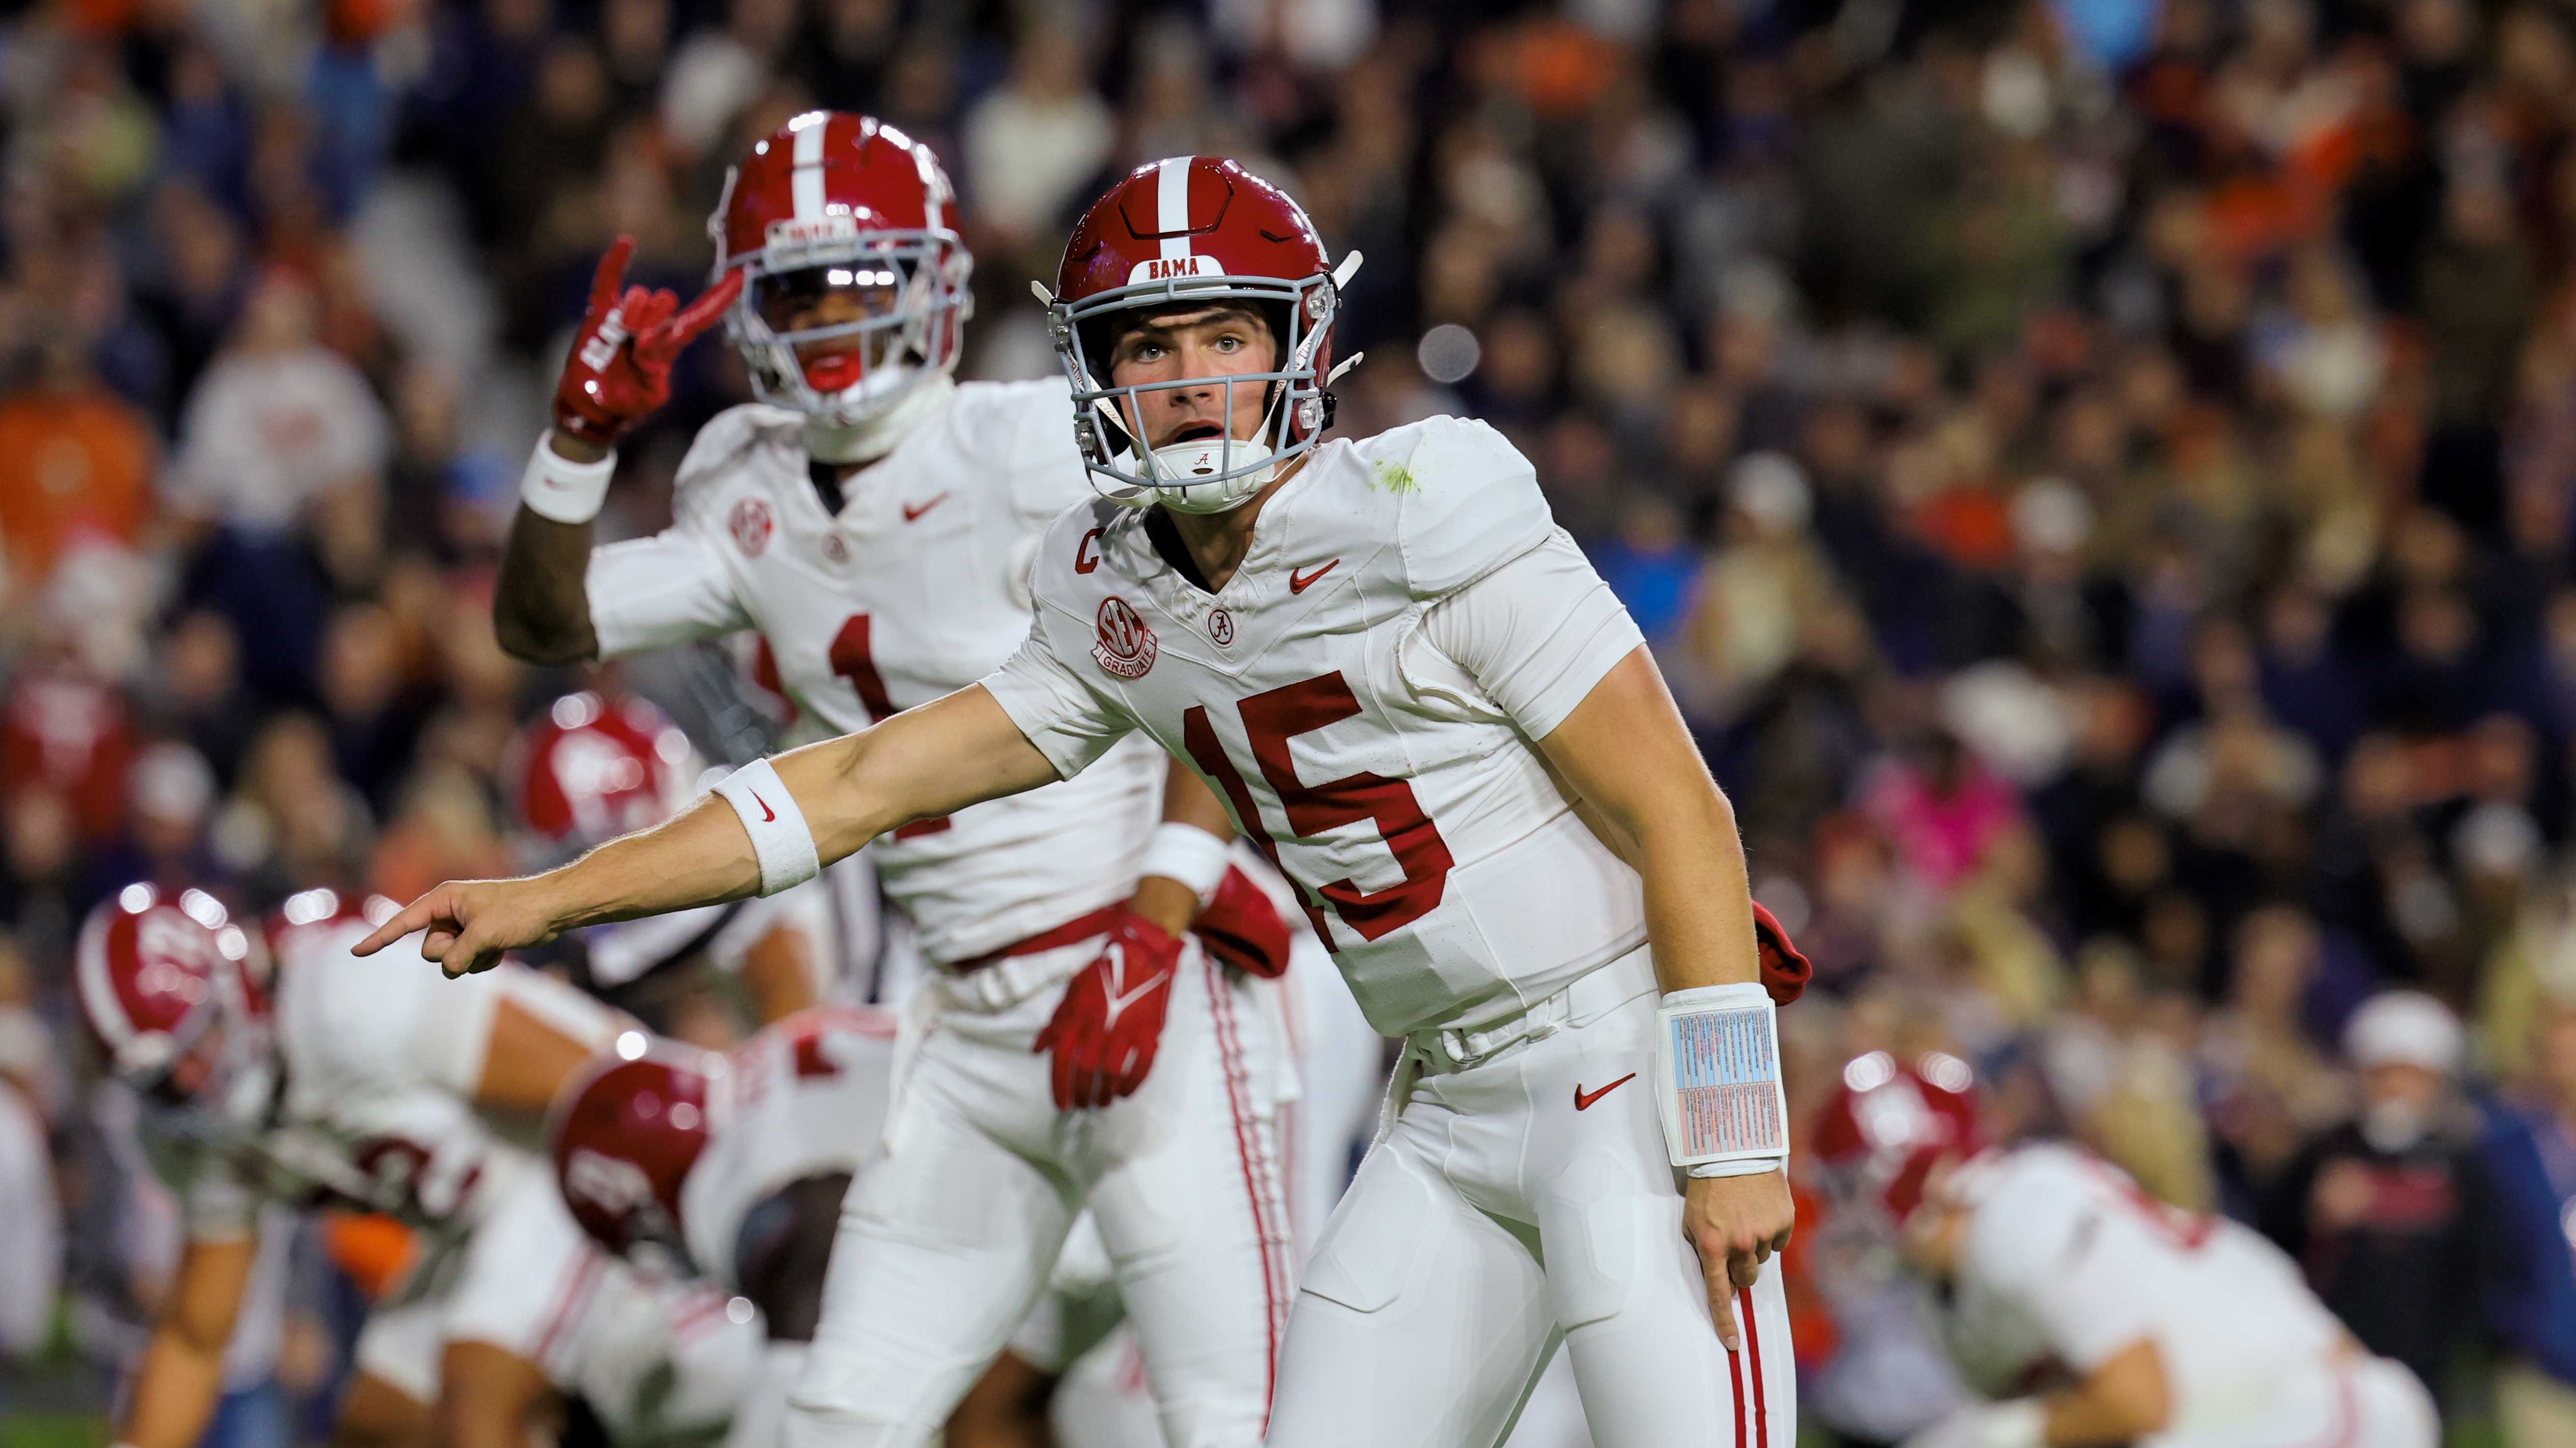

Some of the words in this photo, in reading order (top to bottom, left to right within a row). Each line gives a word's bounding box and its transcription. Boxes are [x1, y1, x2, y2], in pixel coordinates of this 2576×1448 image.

[1149, 258, 1199, 279] BAMA
[1075, 527, 1107, 574] C
[1100, 599, 1142, 656] SEC
[1104, 646, 1154, 676] GRADUATE
[1183, 670, 1456, 954] 15
